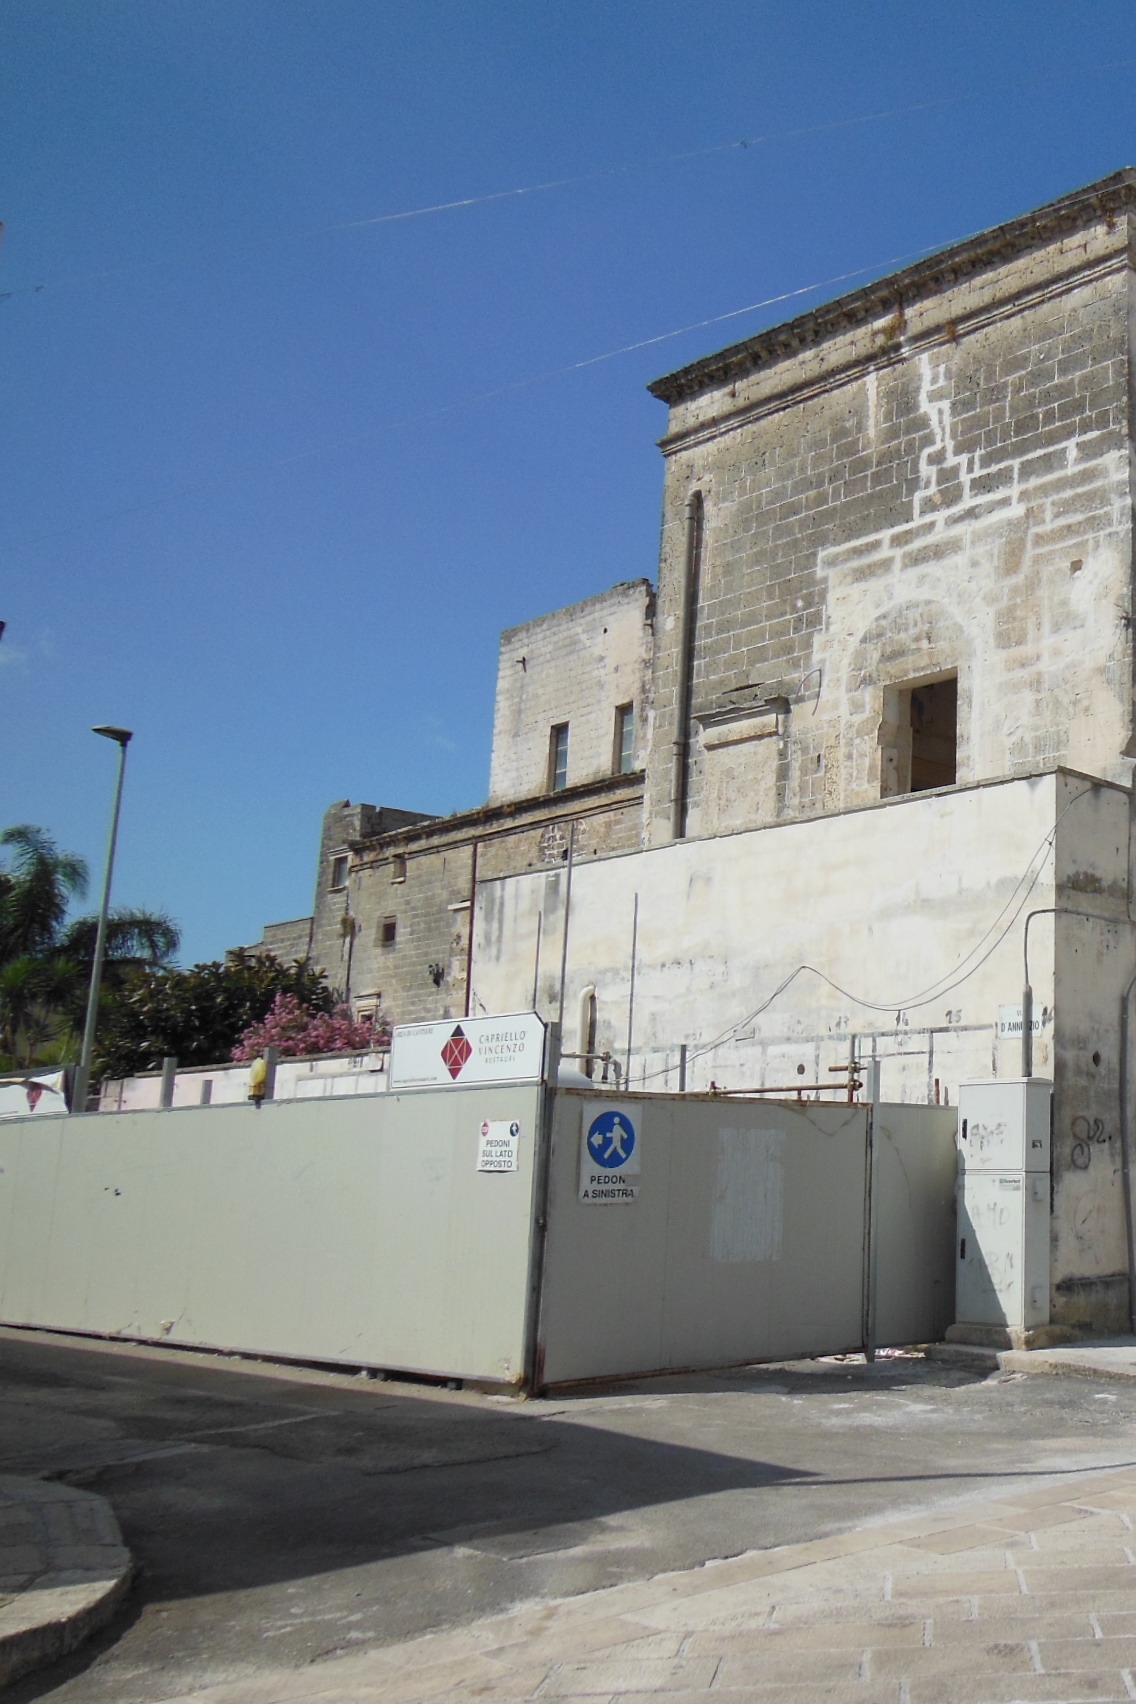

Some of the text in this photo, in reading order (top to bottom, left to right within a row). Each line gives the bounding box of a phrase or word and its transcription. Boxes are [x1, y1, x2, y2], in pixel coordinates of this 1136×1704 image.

[479, 1030, 527, 1044] CAPRIELLO
[478, 1042, 525, 1056] VINCENZO
[486, 1139, 510, 1148] PEDONI
[481, 1149, 513, 1158] SUL LATO
[481, 1159, 513, 1168] OPPOSTO
[590, 1174, 626, 1185] PEDON
[582, 1188, 635, 1199] A SINISTRA
